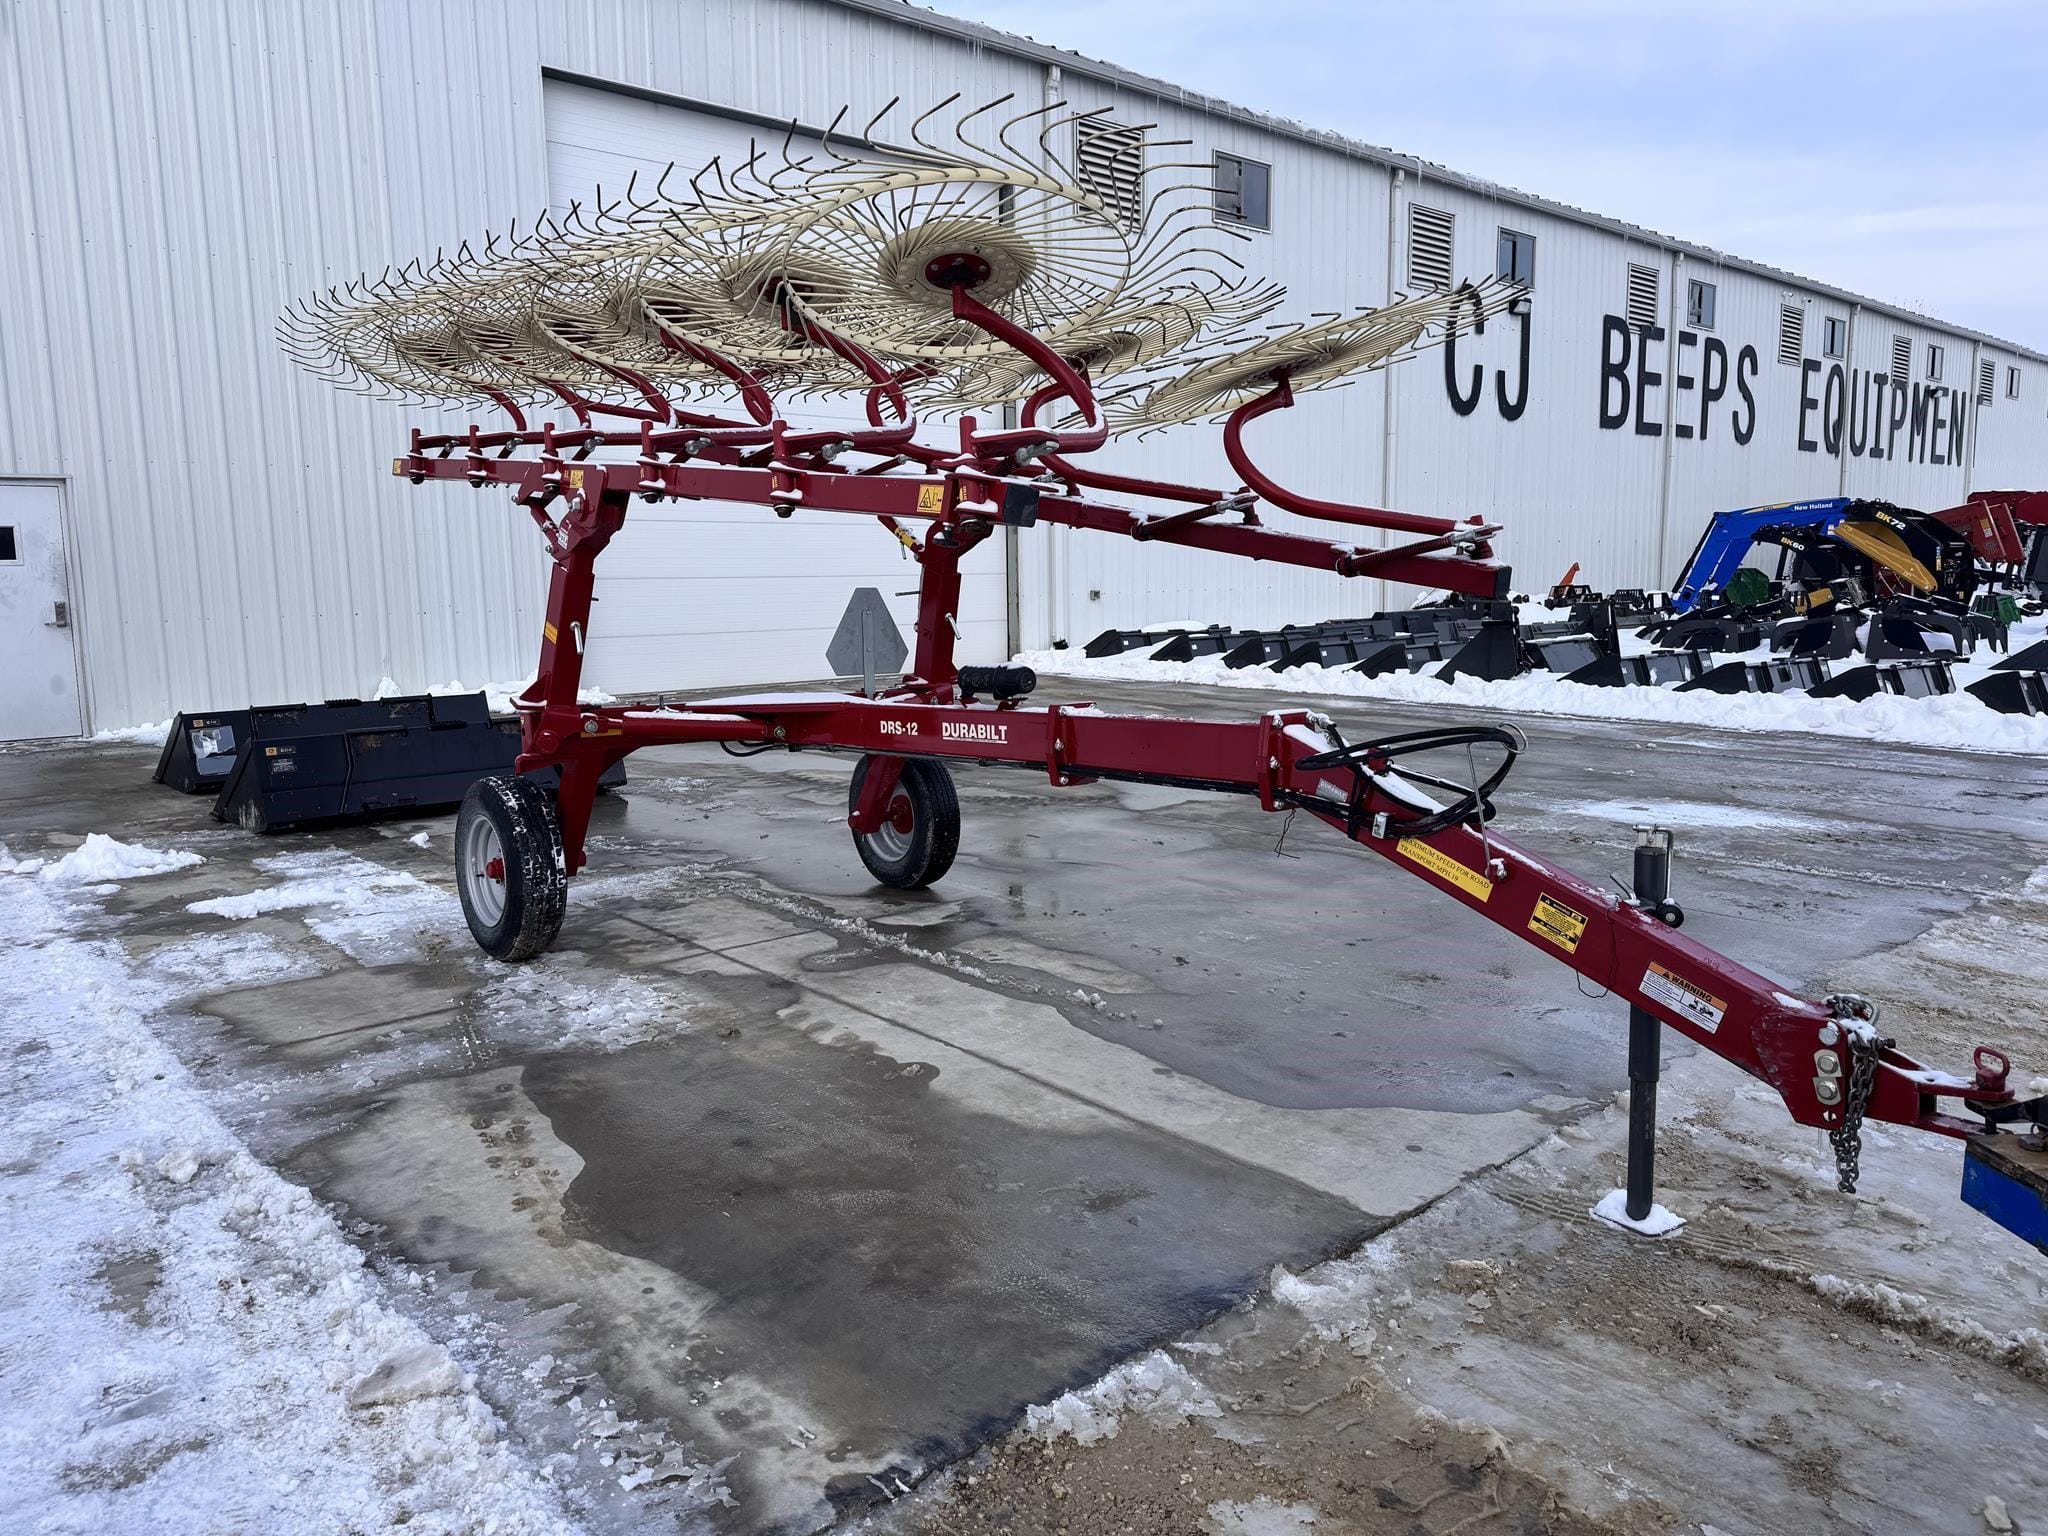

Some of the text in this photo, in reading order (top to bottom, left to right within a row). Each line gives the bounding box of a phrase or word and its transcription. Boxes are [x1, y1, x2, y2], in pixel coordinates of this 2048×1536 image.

[1445, 283, 1531, 421] CJ
[1600, 314, 1758, 446] BEEPS
[1809, 502, 1833, 510] Holland
[1875, 511, 1906, 530] BK72
[880, 720, 1008, 741] DRS-12 DURABILT
[1400, 844, 1459, 882] TRANSPORT MPH 19
[1436, 853, 1456, 870] SPEED
[1456, 865, 1469, 878] FOR
[1470, 874, 1490, 889] ROAD
[1672, 975, 1713, 1003] WARNING
